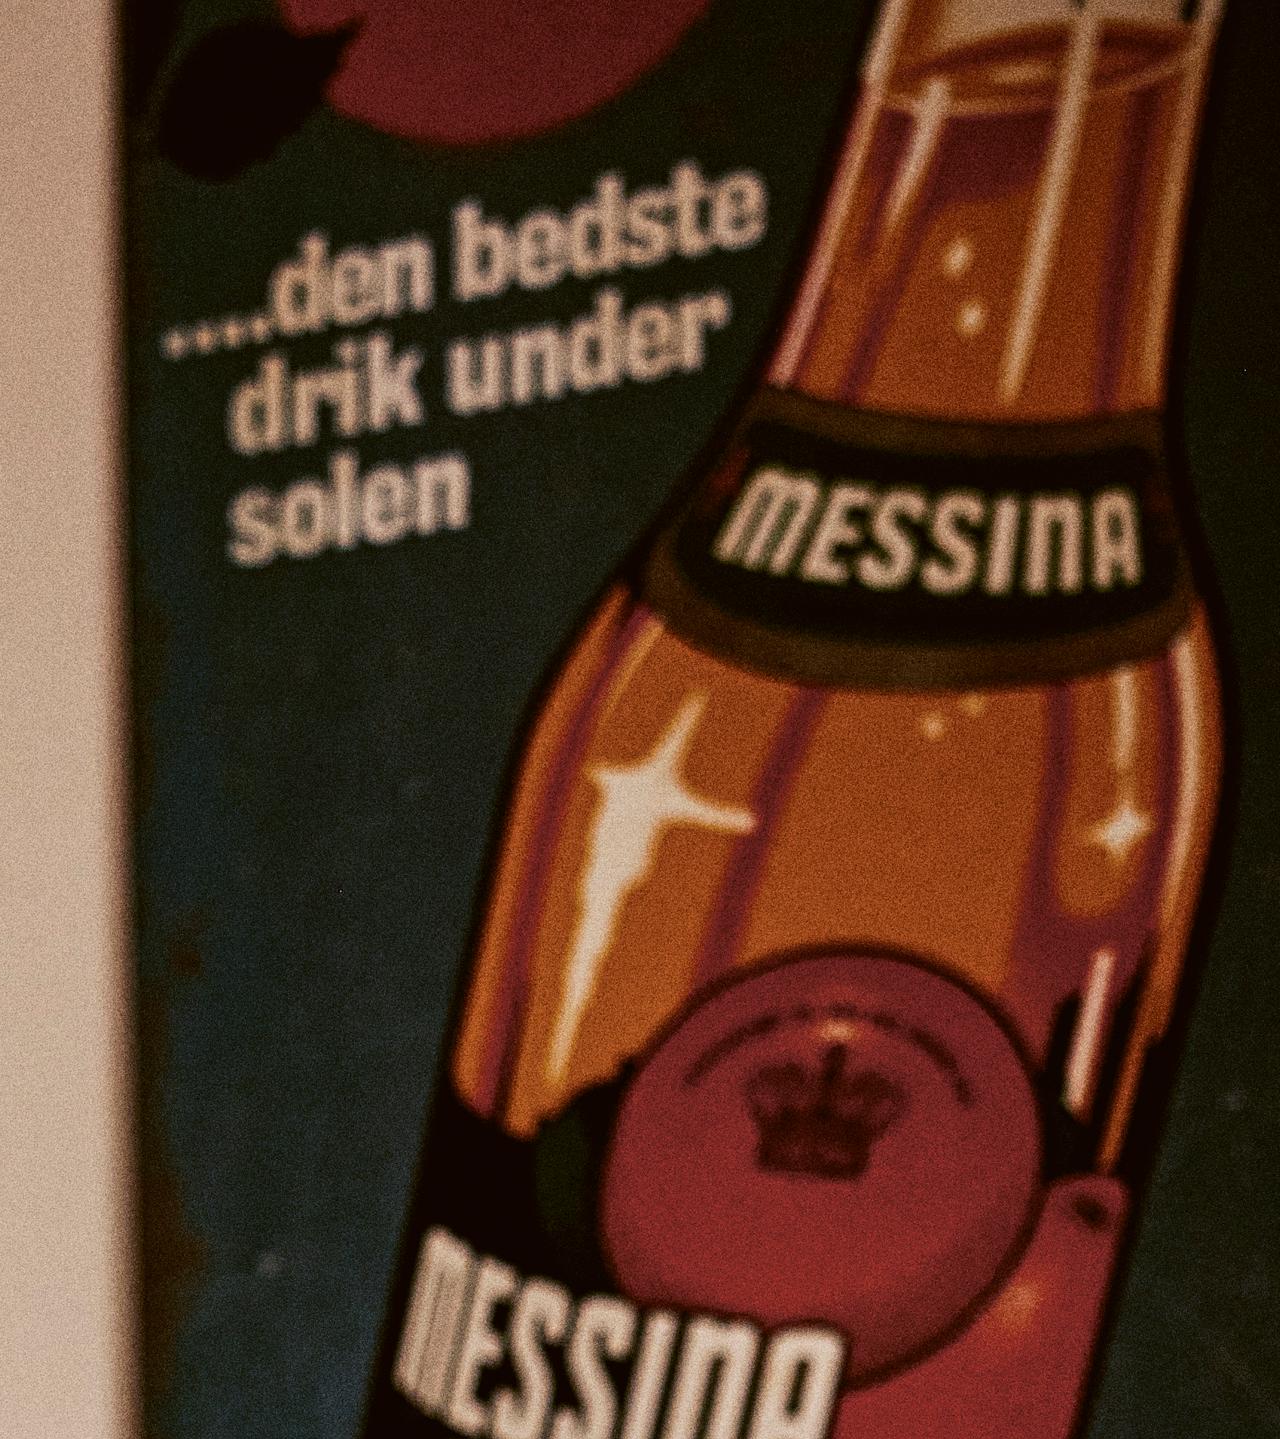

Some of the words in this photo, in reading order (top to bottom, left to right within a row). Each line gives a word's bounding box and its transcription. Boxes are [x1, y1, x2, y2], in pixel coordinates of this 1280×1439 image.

[451, 161, 767, 298] bedste
[229, 333, 423, 455] drik
[446, 289, 732, 417] under
[229, 450, 470, 567] solen
[713, 462, 1142, 597] MESSINA
